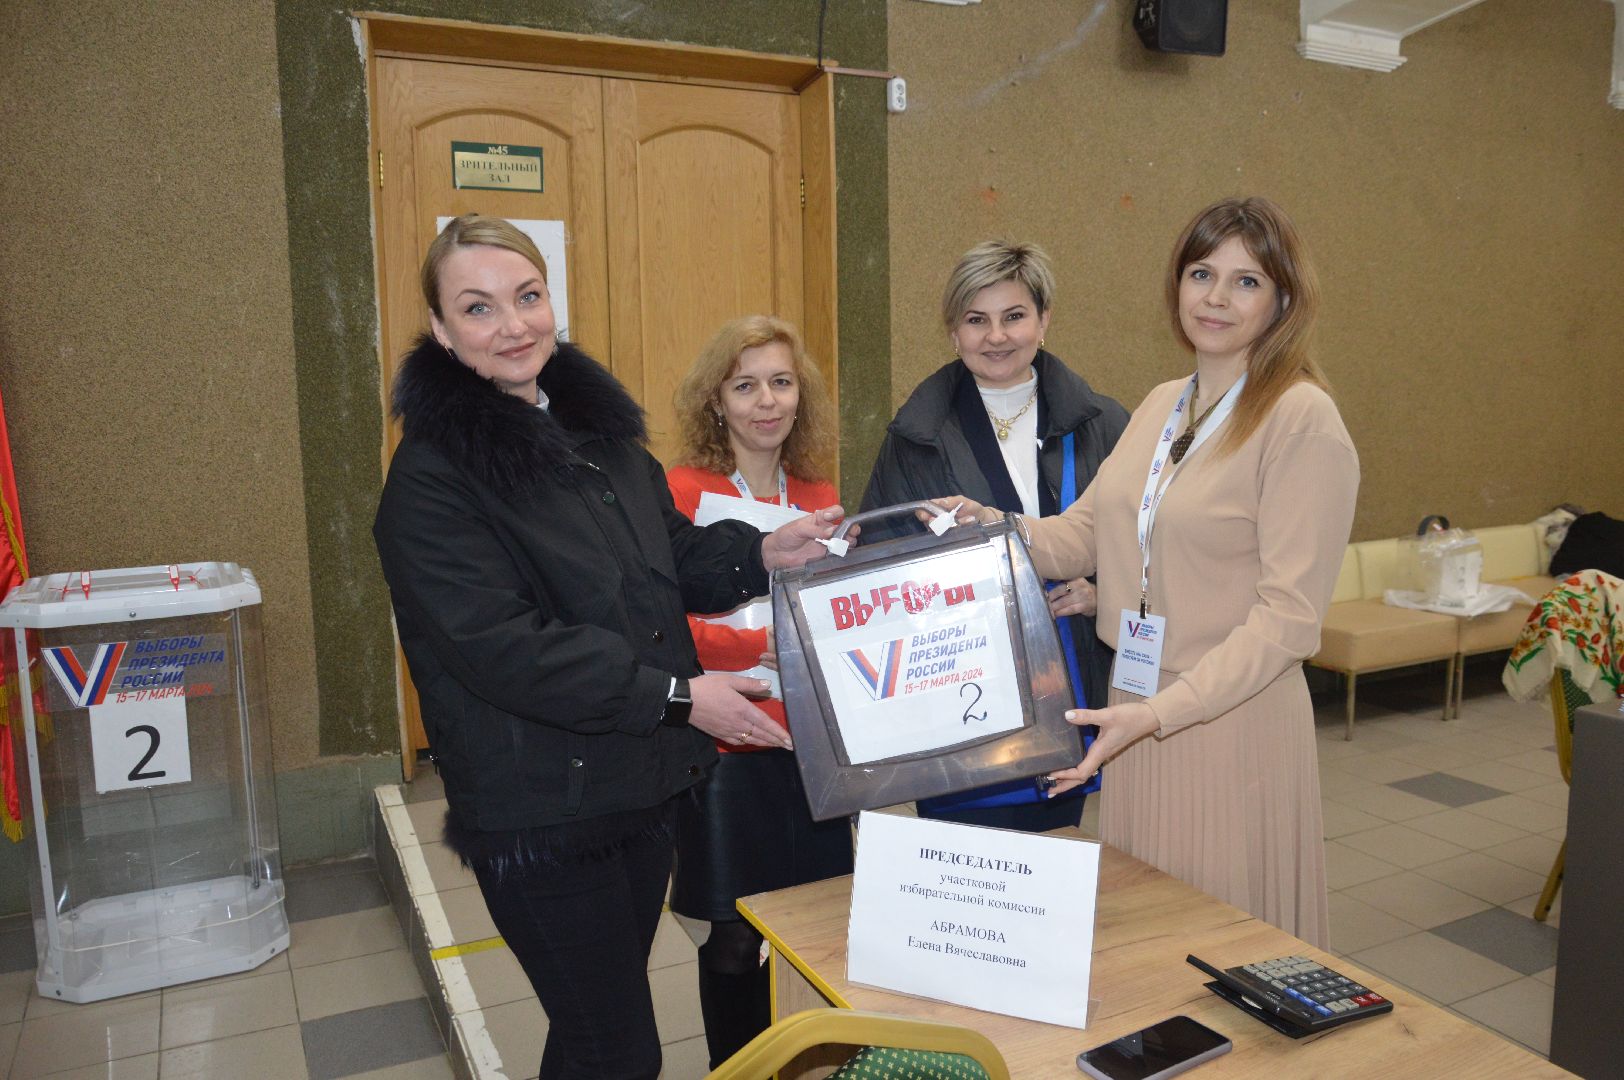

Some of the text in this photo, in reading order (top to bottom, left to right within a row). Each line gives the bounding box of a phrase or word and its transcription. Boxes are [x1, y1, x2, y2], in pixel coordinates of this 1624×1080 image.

[488, 145, 509, 155] №45
[460, 160, 538, 172] ЗРИТЕЛЬНЫЙ
[489, 174, 511, 183] ЗАЛ
[135, 635, 205, 654] ВЫБОРЫ
[911, 624, 967, 648] ВЫБОРЫ
[128, 650, 225, 671] ПРЕЗИДЕНТА
[908, 635, 987, 665] ПРЕЗИДЕНТА
[121, 670, 185, 689] РОССИИ
[906, 658, 956, 681] РОССИИ
[930, 672, 960, 690] МАРТА
[961, 667, 984, 682] 2024
[148, 685, 186, 701] МАРТА
[960, 682, 988, 725] 2
[125, 724, 166, 781] 2
[919, 848, 1033, 876] ПРЕДСЕДАТЕЛЬ
[939, 873, 1007, 893] участковой
[899, 882, 1046, 916] избирательной комиссии
[930, 919, 1007, 944] АБРАМОВА
[907, 935, 1027, 969] Елена Вячеславовна
